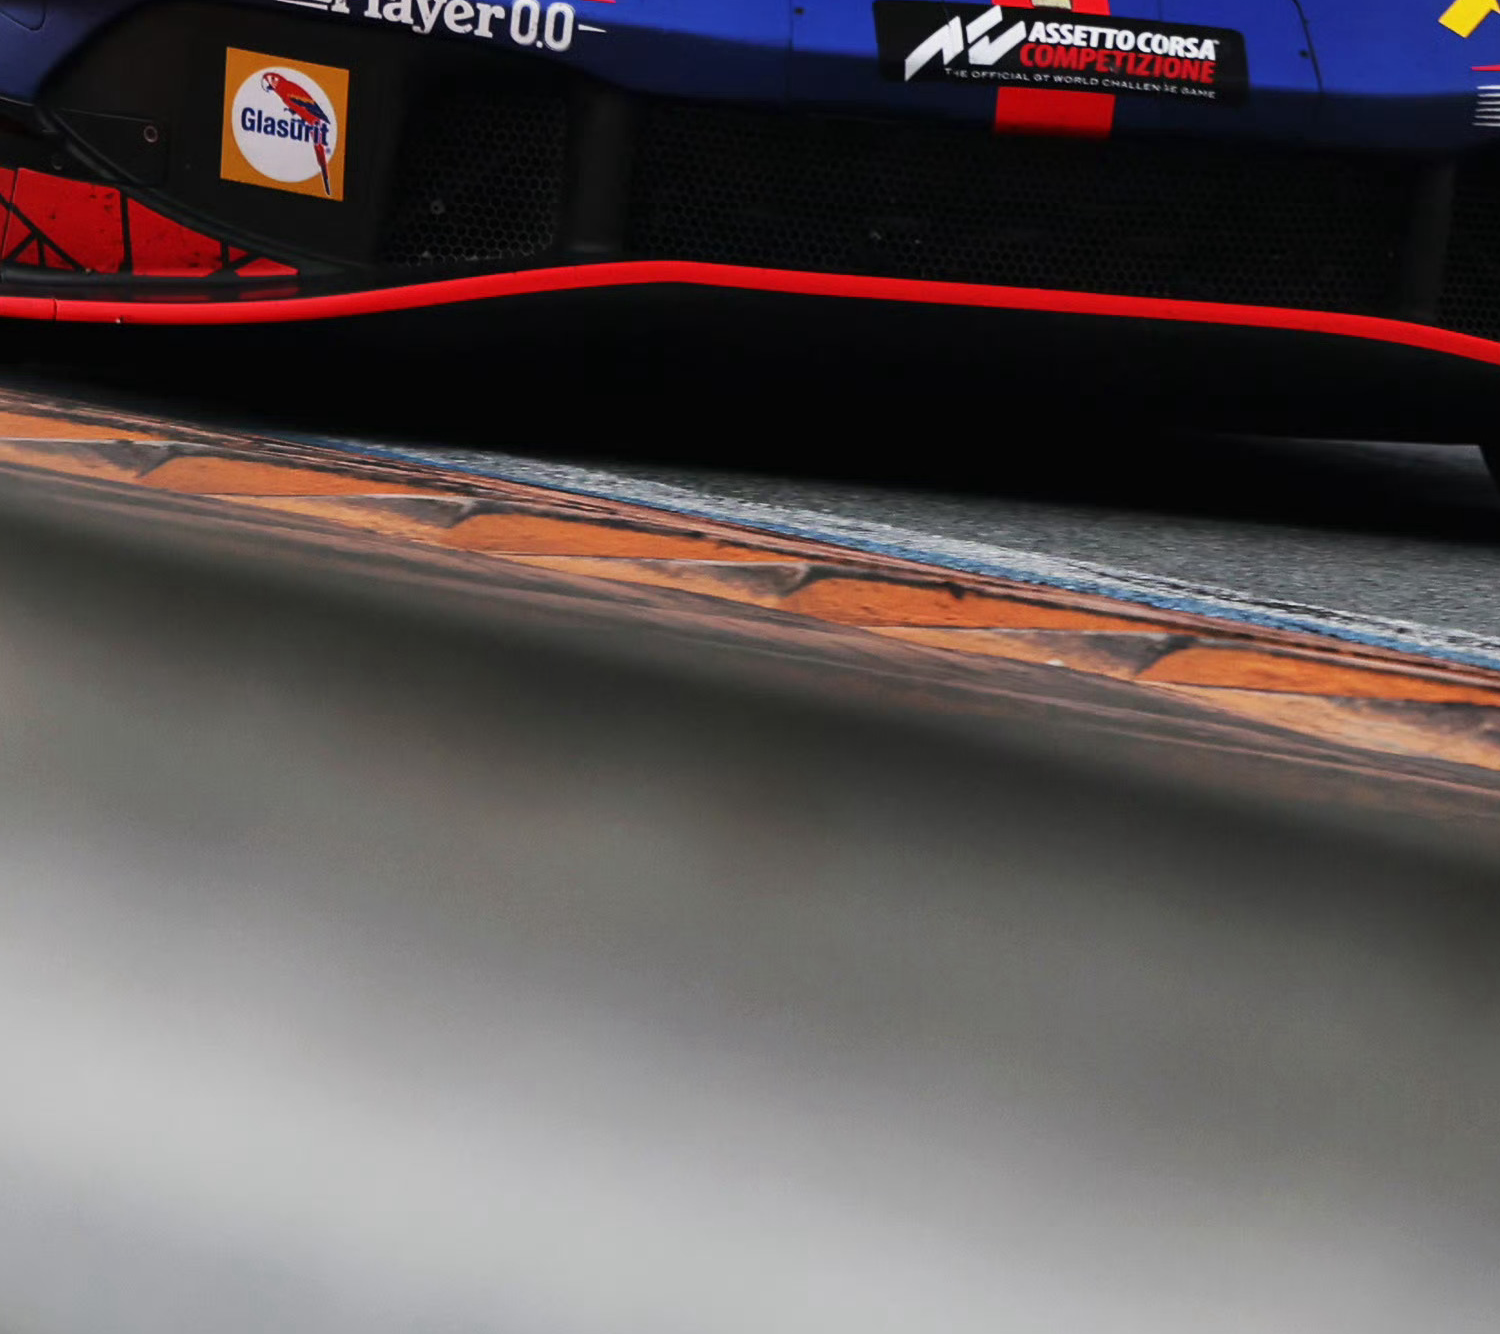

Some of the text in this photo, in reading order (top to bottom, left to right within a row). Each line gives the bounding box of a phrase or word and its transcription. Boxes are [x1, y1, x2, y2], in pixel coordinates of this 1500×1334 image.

[1028, 20, 1217, 61] ASSETTO CORSA
[1020, 43, 1217, 84] COMPETIZIONE
[970, 70, 1031, 82] OFFICIAL
[1053, 74, 1100, 86] WORLD
[1181, 86, 1217, 99] GAME
[241, 106, 330, 147] Glasurit
